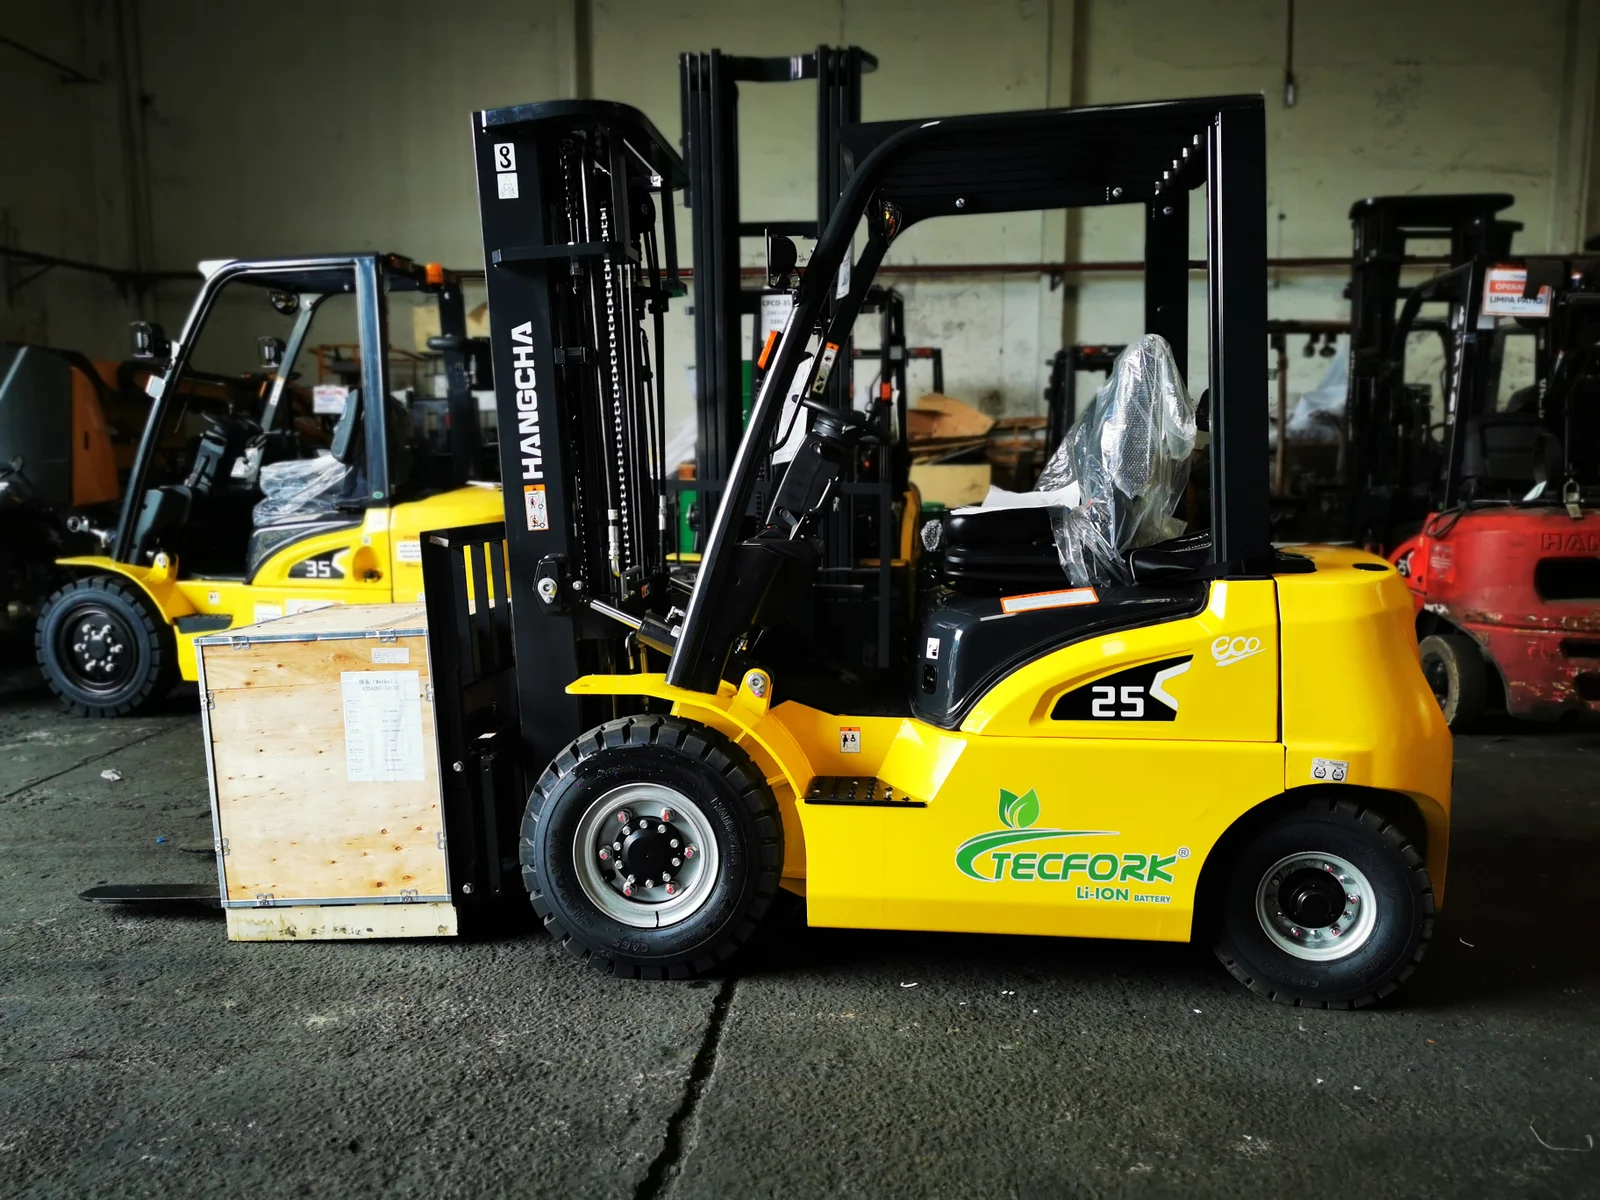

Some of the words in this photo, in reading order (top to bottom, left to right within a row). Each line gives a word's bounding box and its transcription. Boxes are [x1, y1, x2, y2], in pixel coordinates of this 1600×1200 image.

[1490, 296, 1516, 304] LIMPA
[511, 320, 544, 480] HANGCHA
[305, 560, 331, 578] 35
[1091, 685, 1145, 718] 25
[1133, 893, 1172, 904] BATTERY
